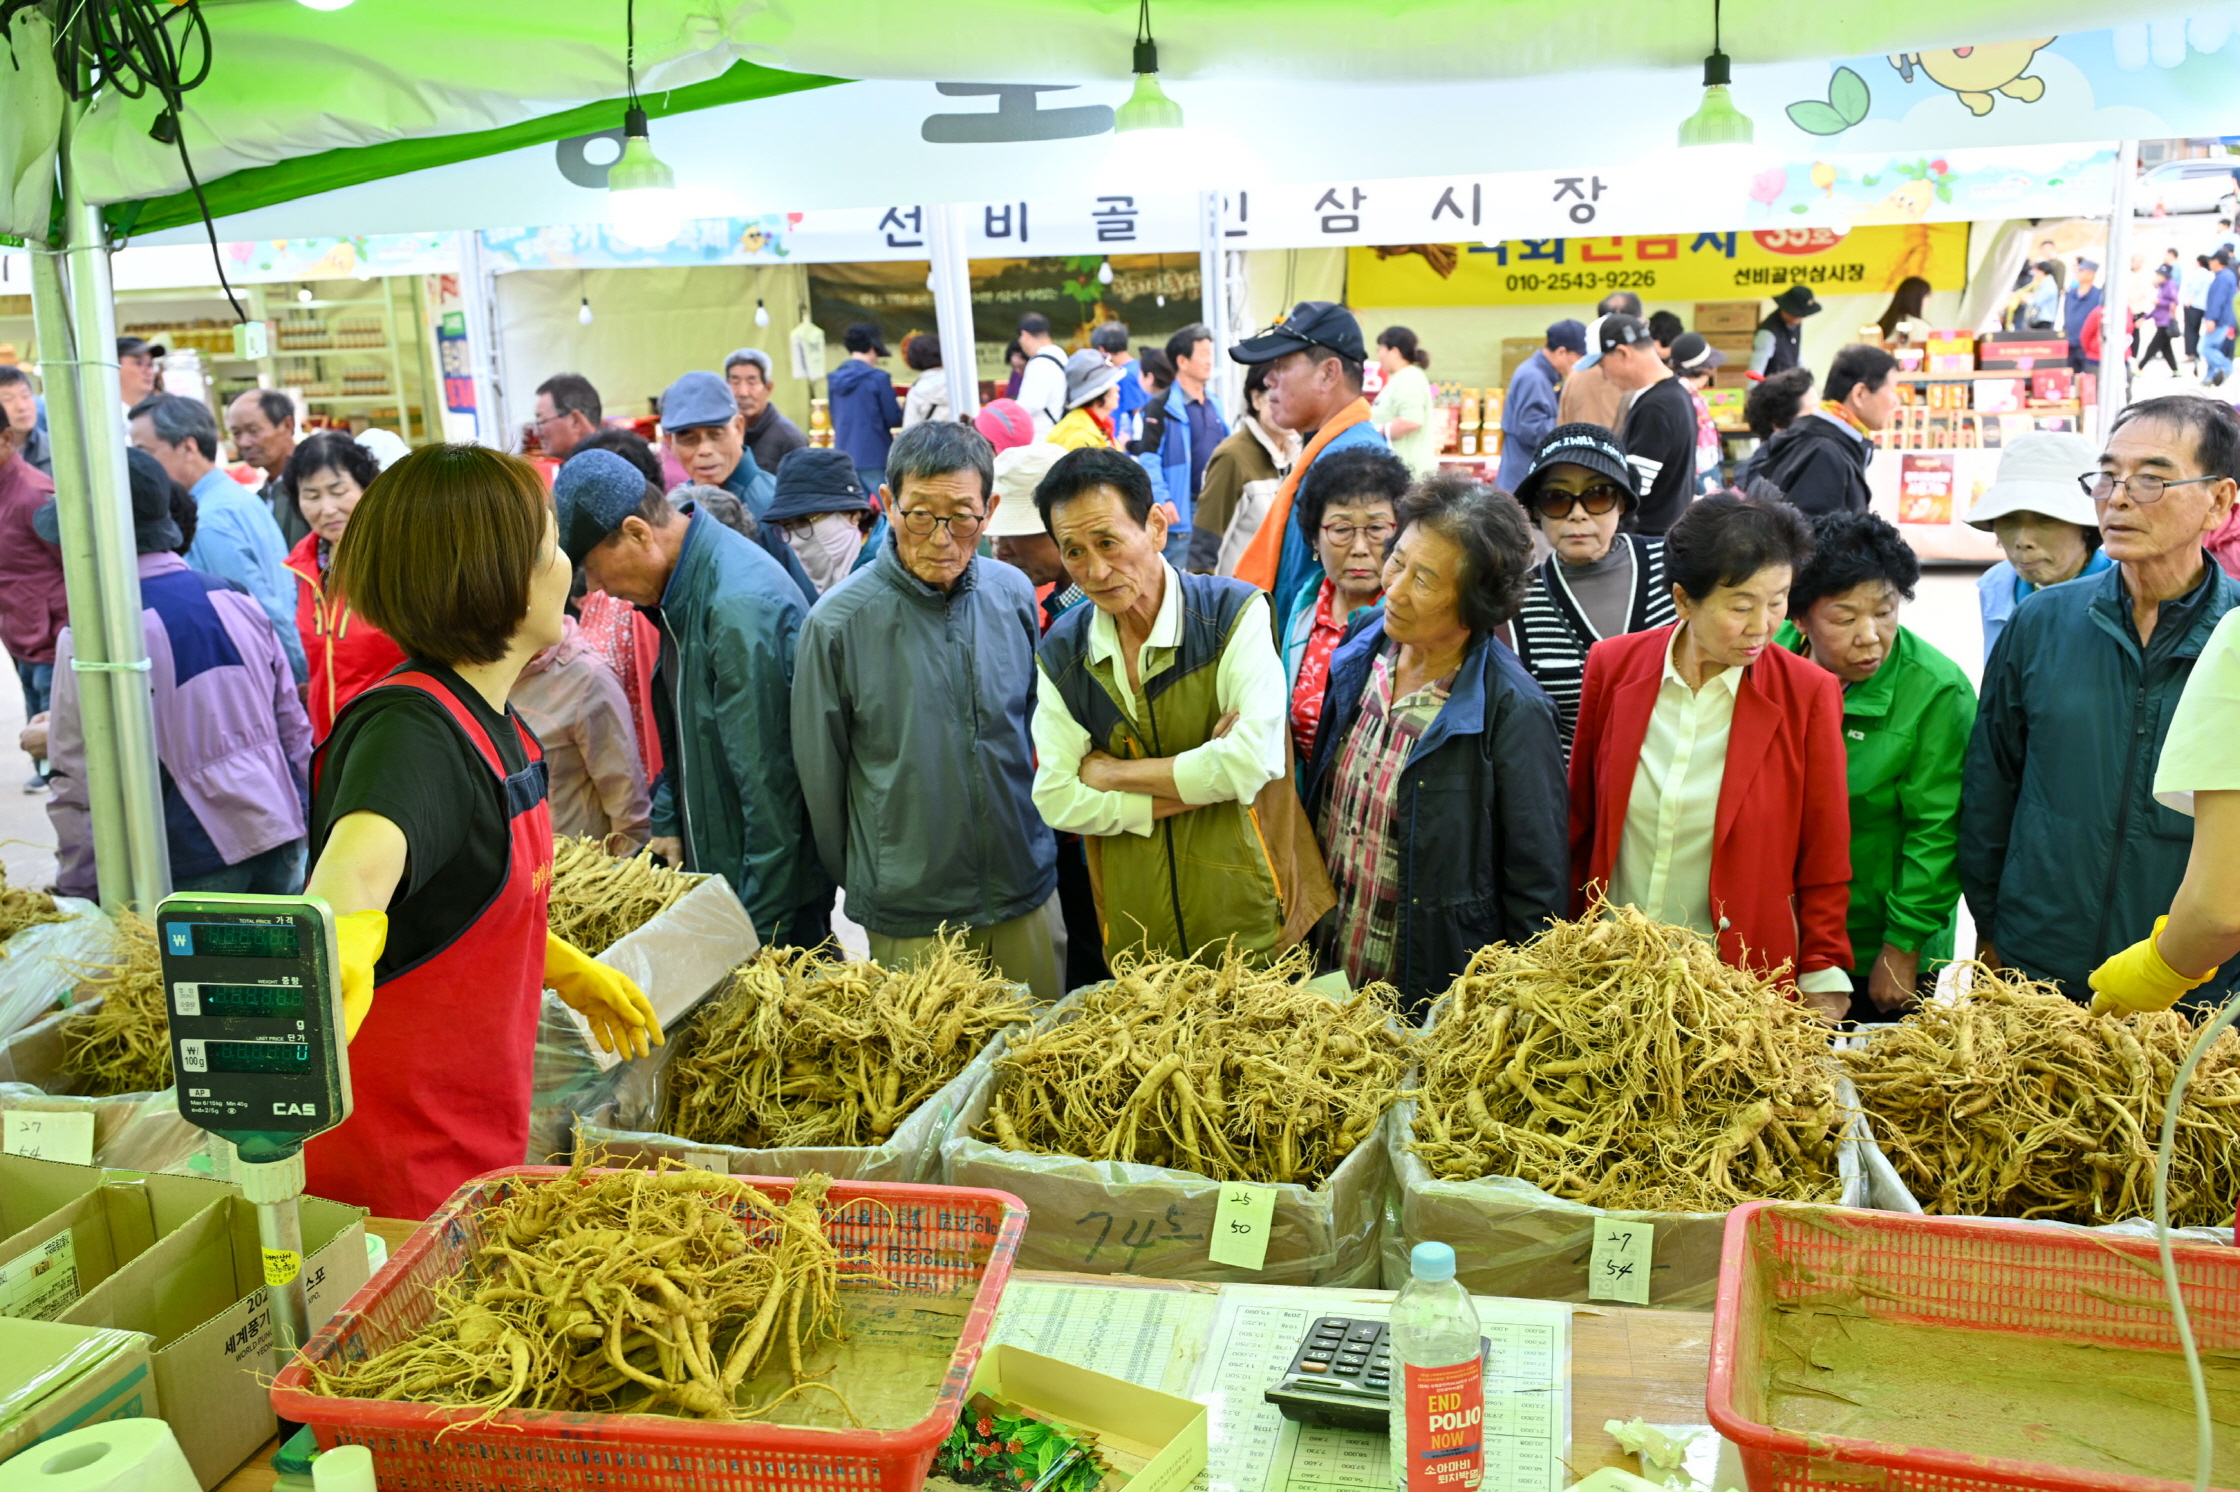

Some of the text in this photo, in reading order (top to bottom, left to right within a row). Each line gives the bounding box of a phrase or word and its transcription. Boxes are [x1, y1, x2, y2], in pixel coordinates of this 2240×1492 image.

[1506, 269, 1656, 291] 010-2543-9226
[1735, 264, 1865, 286] 선비골인삼시장
[276, 915, 293, 925] 가격
[297, 1020, 305, 1031] g
[185, 1057, 198, 1065] 100
[273, 1103, 316, 1116] CAS
[1230, 1219, 1251, 1234] 50
[1607, 1259, 1634, 1281] 54
[223, 1308, 271, 1357] 세계풍기
[1428, 1392, 1461, 1413] END
[1429, 1406, 1481, 1432] POLIO
[1431, 1430, 1465, 1450] NOW
[1424, 1459, 1471, 1475] 소아마비
